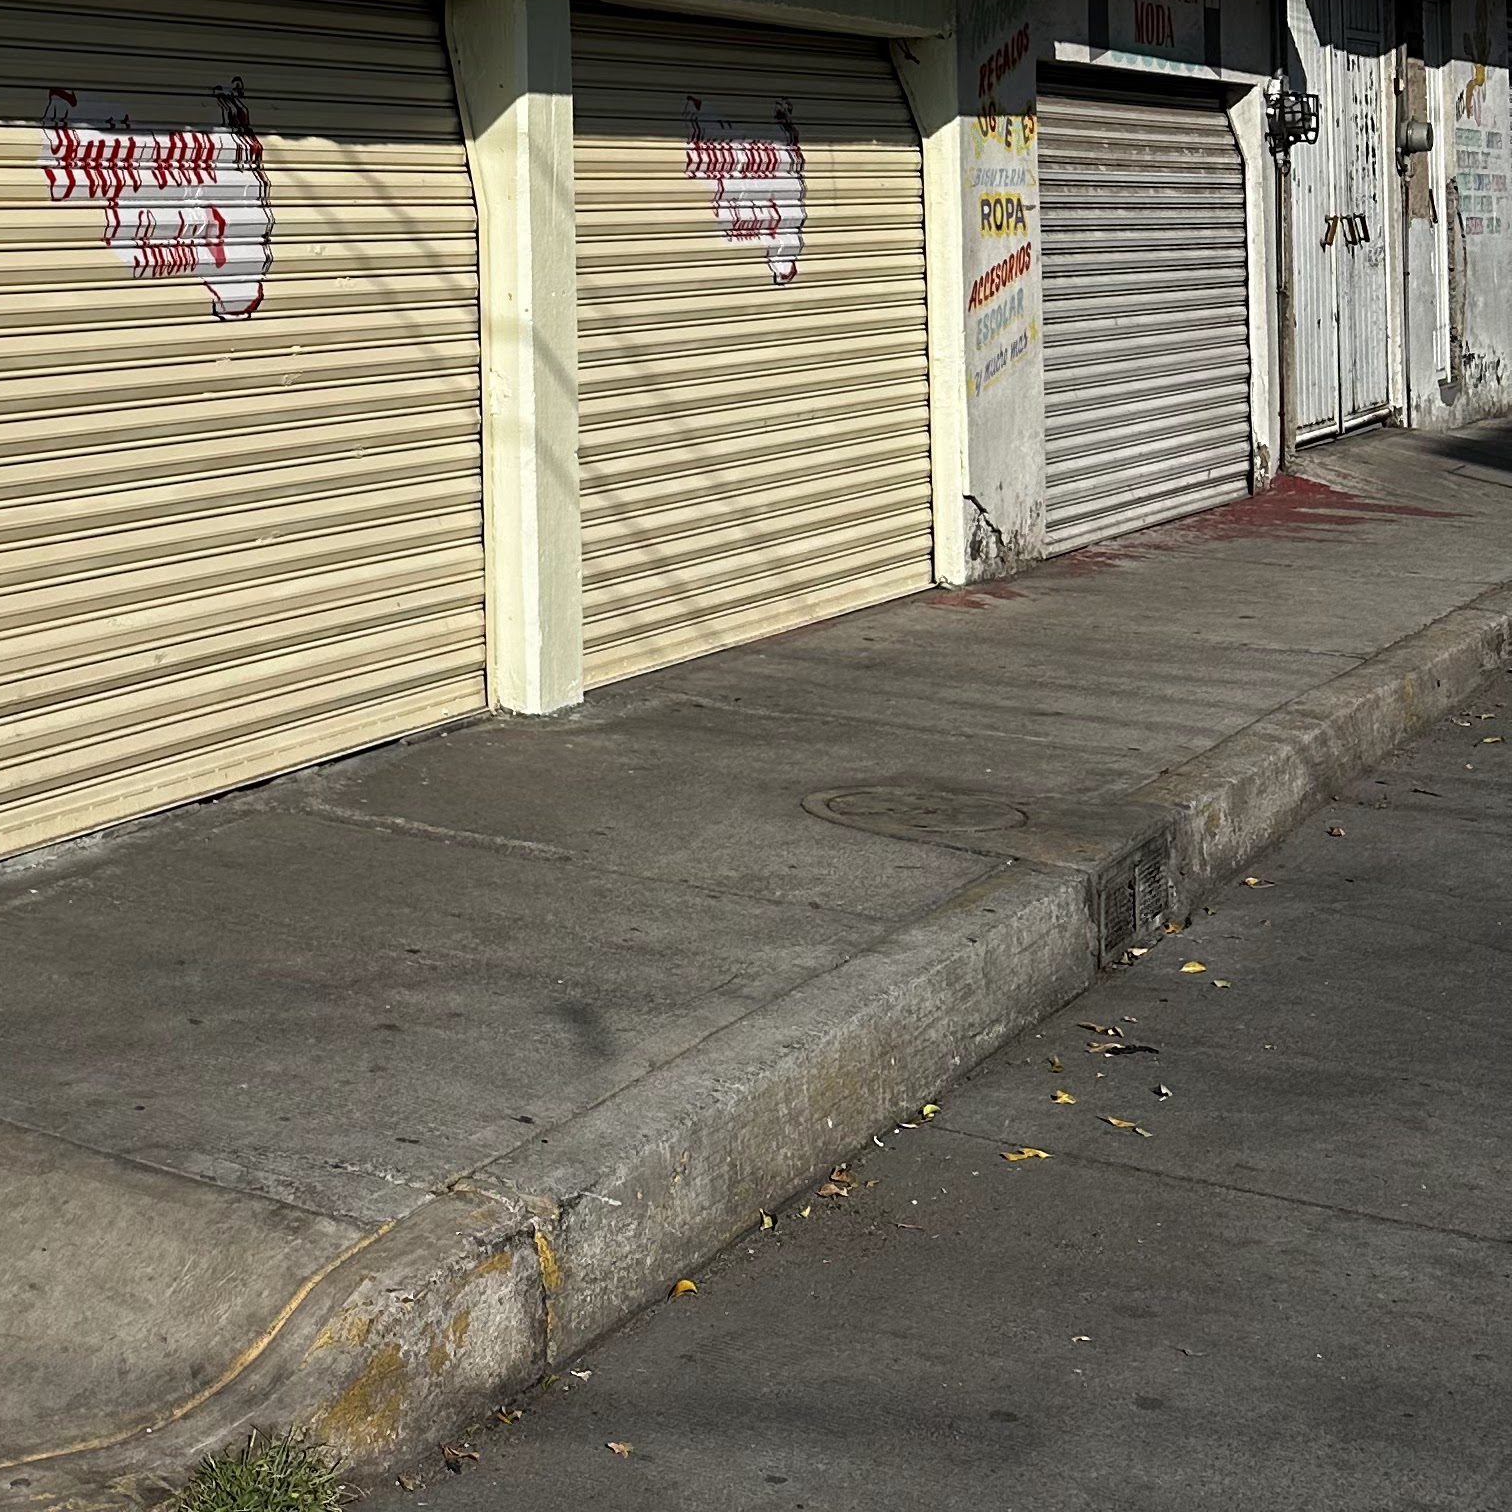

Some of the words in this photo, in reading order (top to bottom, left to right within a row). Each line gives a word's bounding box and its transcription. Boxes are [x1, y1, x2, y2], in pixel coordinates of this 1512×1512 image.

[1134, 0, 1174, 48] MODA
[978, 23, 1029, 98] REGALOS
[980, 197, 1026, 231] ROPA
[968, 241, 1031, 312] ACCESORIOS
[976, 288, 1024, 348] ESCOLAR
